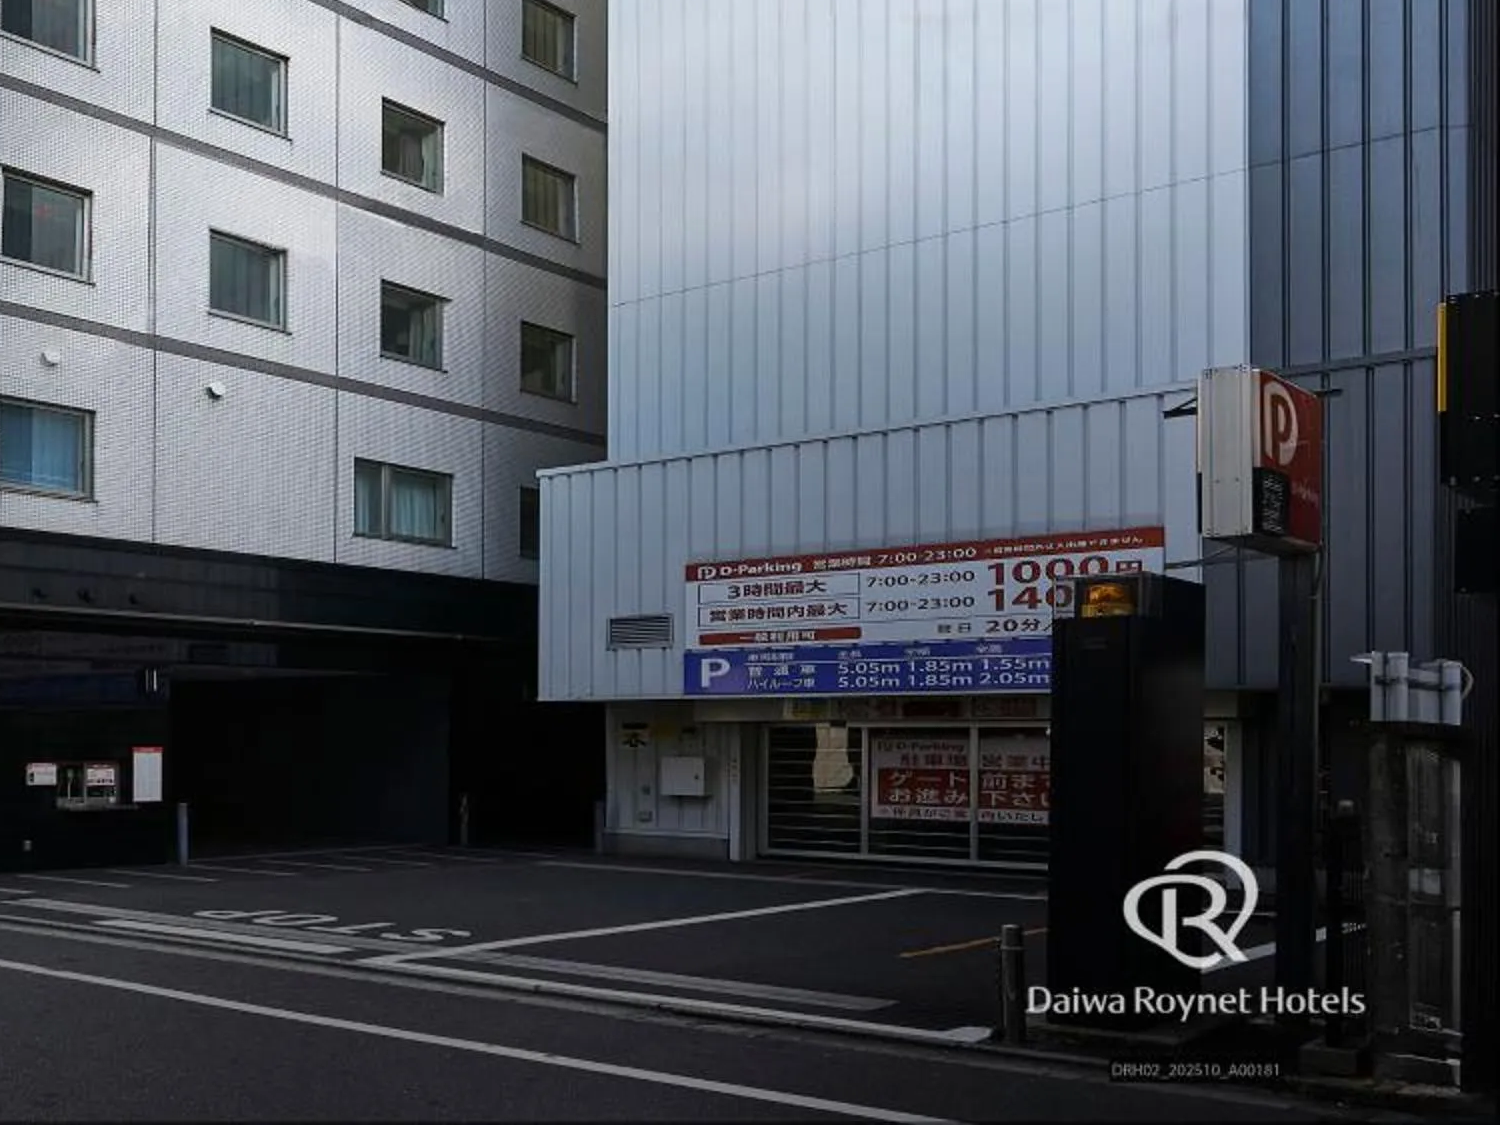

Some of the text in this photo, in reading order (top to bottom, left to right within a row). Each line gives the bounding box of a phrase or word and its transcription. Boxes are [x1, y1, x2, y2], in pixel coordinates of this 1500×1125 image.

[720, 561, 802, 576] D-Parking
[812, 555, 871, 571] 営業時間
[877, 547, 977, 565] 7:00-23:00
[727, 579, 827, 600] 3時間最大
[867, 570, 976, 588] 7:00-23:00
[708, 601, 848, 623] 営業時間内最大
[867, 595, 976, 613] 7:00-23:00
[701, 657, 731, 688] P
[837, 662, 900, 675] 5.05m
[908, 660, 973, 673] 1.85m
[982, 658, 1050, 671] 1.55m
[837, 675, 900, 688] 5.05m
[908, 674, 973, 686] 1.85m
[980, 672, 1050, 685] 2.05m
[194, 909, 471, 942] STOP
